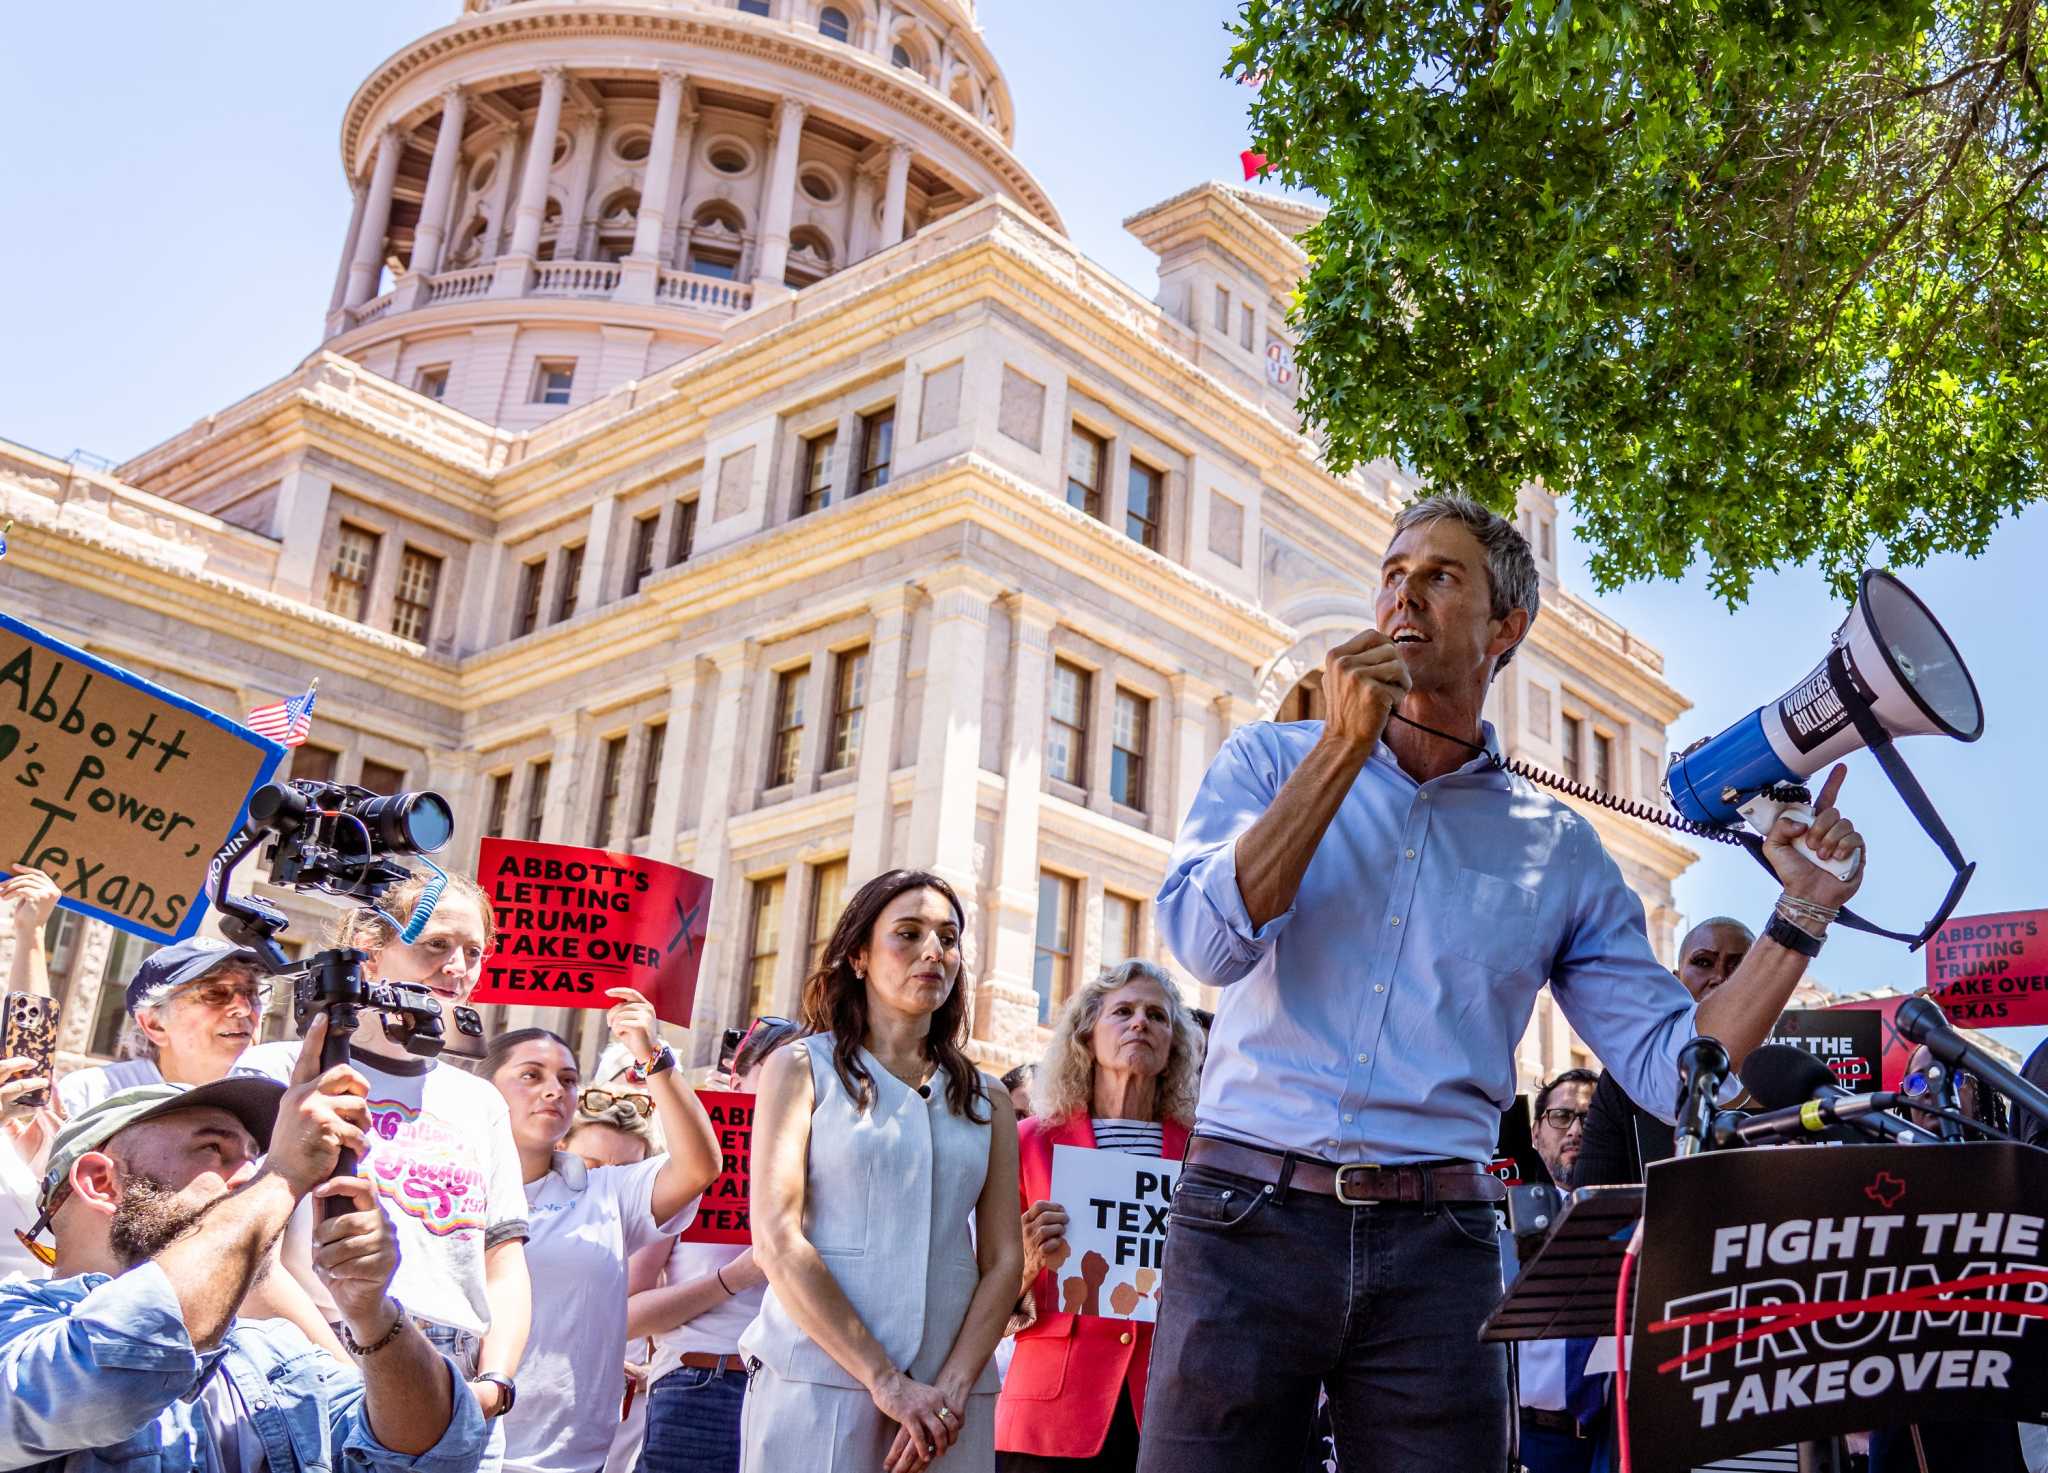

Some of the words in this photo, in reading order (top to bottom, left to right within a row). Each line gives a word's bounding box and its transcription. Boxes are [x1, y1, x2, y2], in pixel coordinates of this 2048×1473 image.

[0, 646, 190, 773] Abbott
[1783, 669, 1831, 718] WORKERS
[1792, 686, 1845, 736] BILLIONA
[64, 755, 201, 857] Power,
[18, 798, 187, 929] Texans
[210, 831, 249, 884] RONIN
[497, 855, 651, 892] ABBOTT'S
[496, 881, 631, 913] LETTING
[493, 907, 608, 934] TRUMP
[1935, 921, 2038, 944] ABBOTT'S
[495, 934, 580, 958] TAKE
[587, 939, 661, 969] OVER
[1935, 940, 2024, 961] LETTING
[487, 967, 595, 993] TEXAS
[1935, 960, 2010, 979] TRUMP
[1935, 978, 1993, 997] TAKE
[1806, 1036, 1853, 1054] THE
[1711, 1214, 1905, 1275] FIGHT
[1916, 1213, 2046, 1256] THE
[1663, 1261, 2048, 1381] TRUMP
[1692, 1350, 2012, 1428] TAKEOVER
